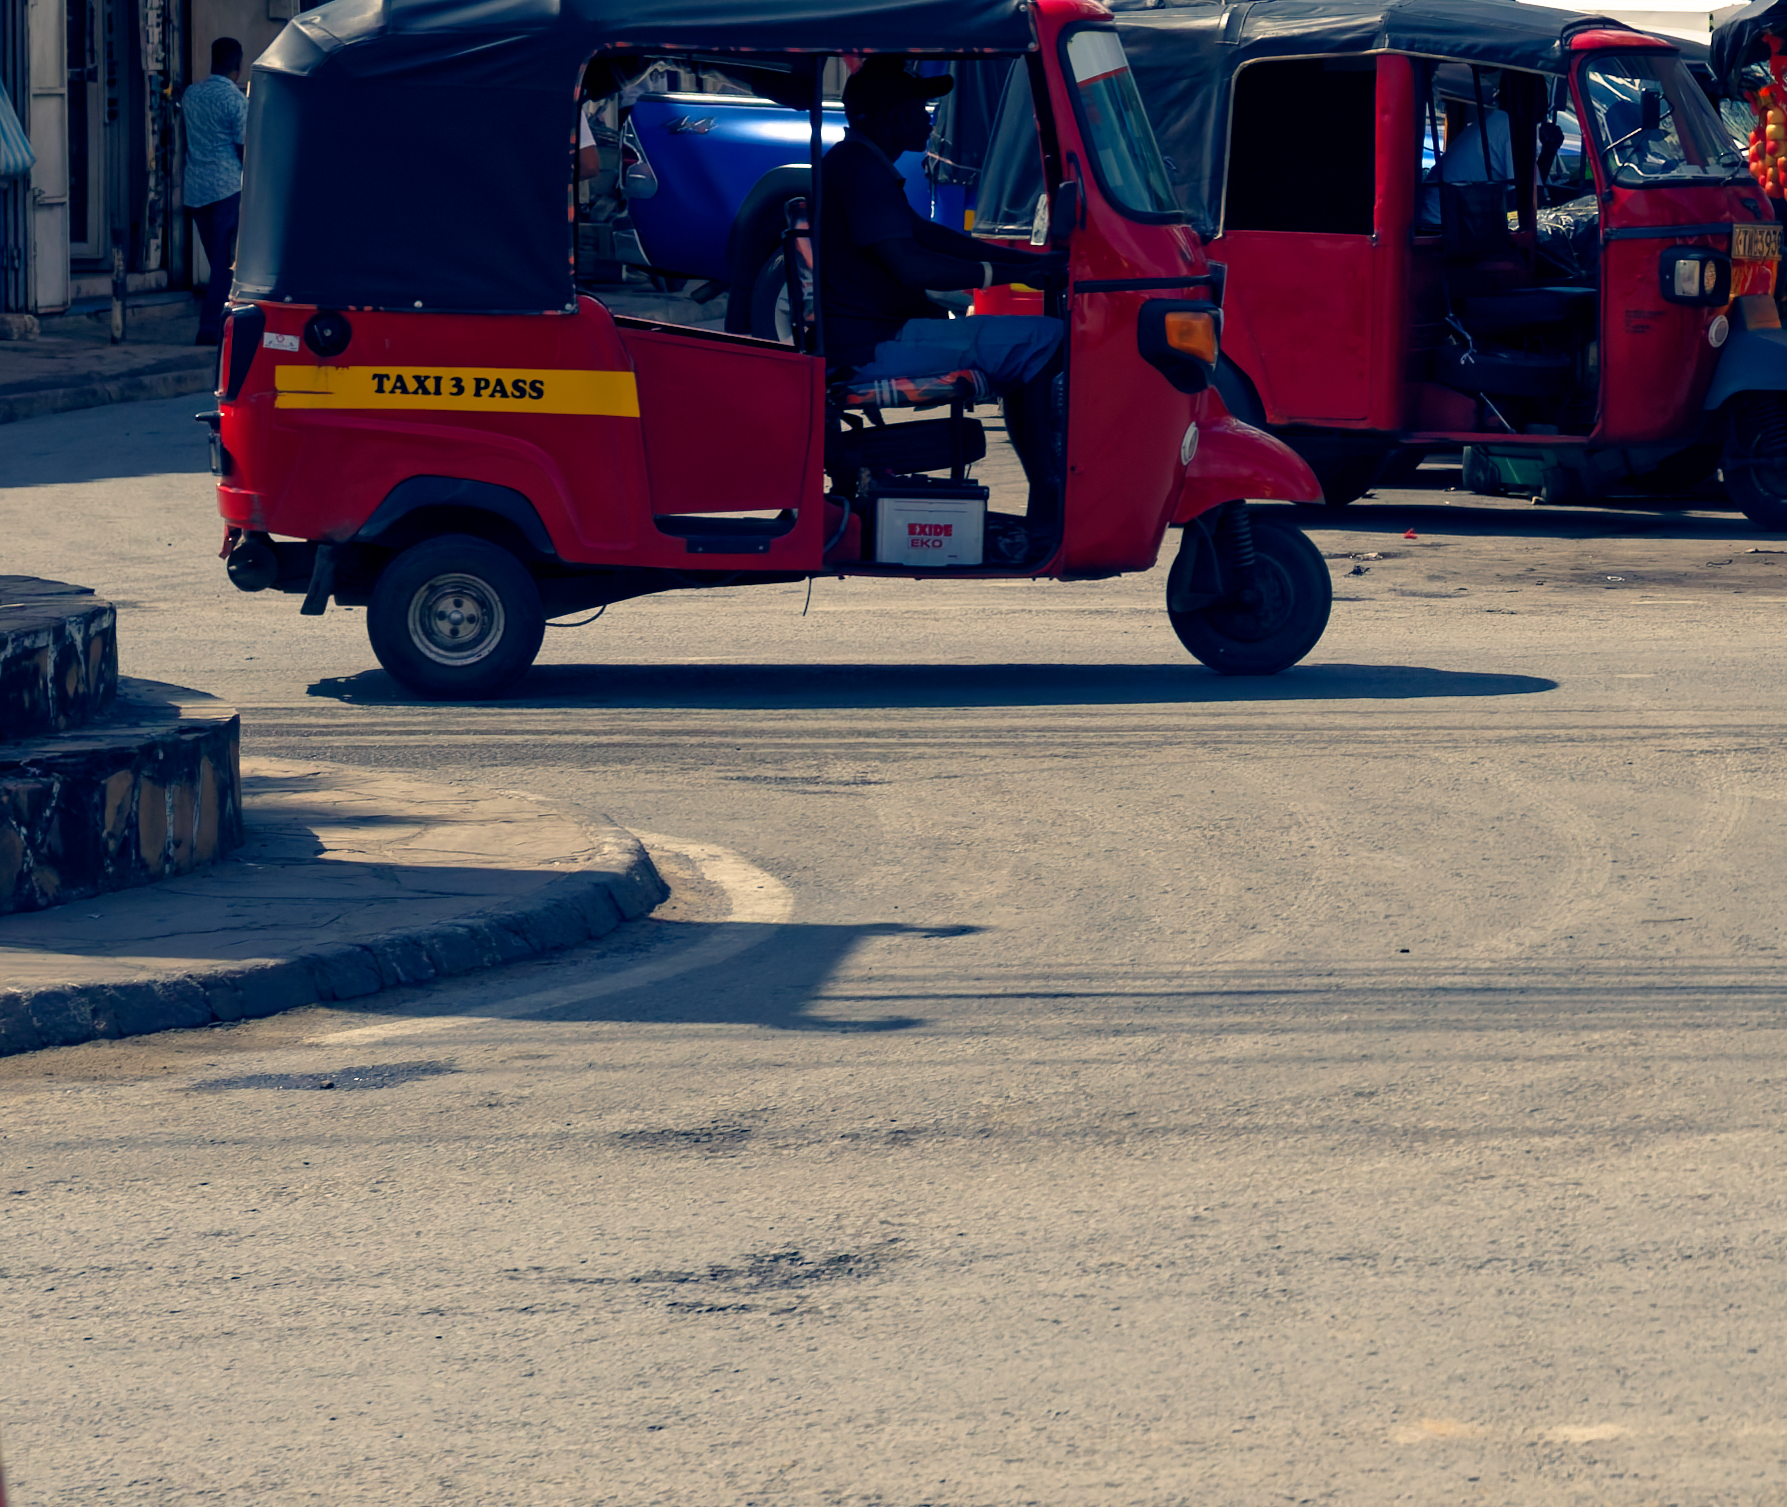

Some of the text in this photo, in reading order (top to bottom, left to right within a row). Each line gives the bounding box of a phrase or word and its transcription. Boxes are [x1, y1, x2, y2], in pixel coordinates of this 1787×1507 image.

[372, 373, 545, 400] TAXI 3 PASS
[908, 523, 952, 536] EXIDE
[911, 539, 942, 548] EKO
